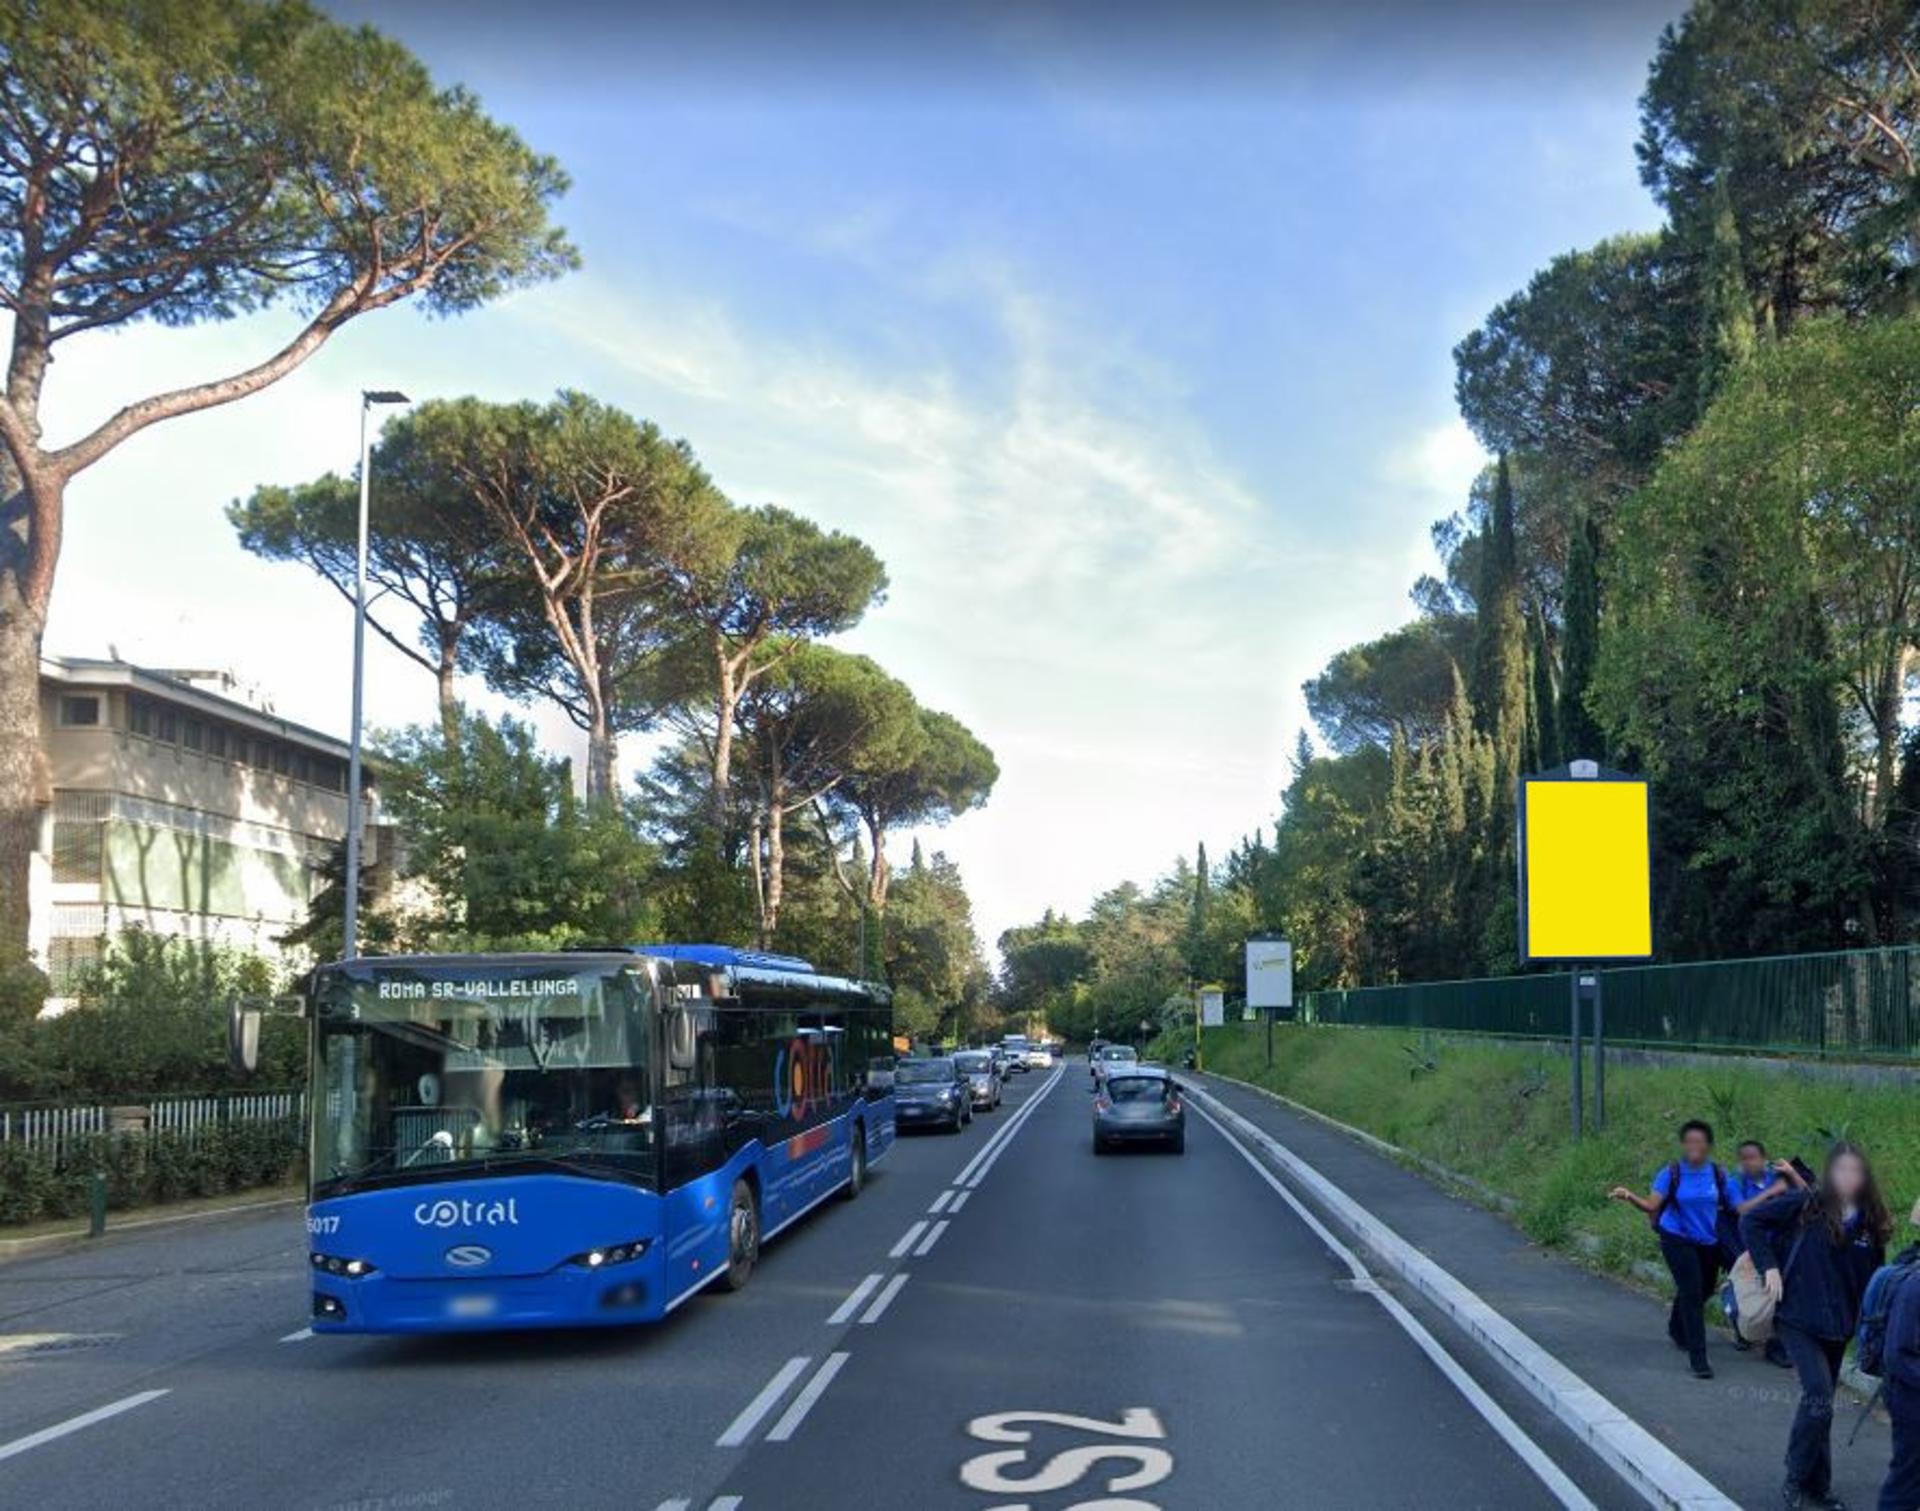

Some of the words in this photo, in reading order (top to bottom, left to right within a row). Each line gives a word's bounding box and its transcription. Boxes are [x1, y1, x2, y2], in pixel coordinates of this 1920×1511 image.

[380, 982, 425, 999] ROMA
[432, 979, 578, 998] SR-VALLELUNGA
[415, 1198, 519, 1227] cotral
[960, 1407, 1173, 1511] S2
